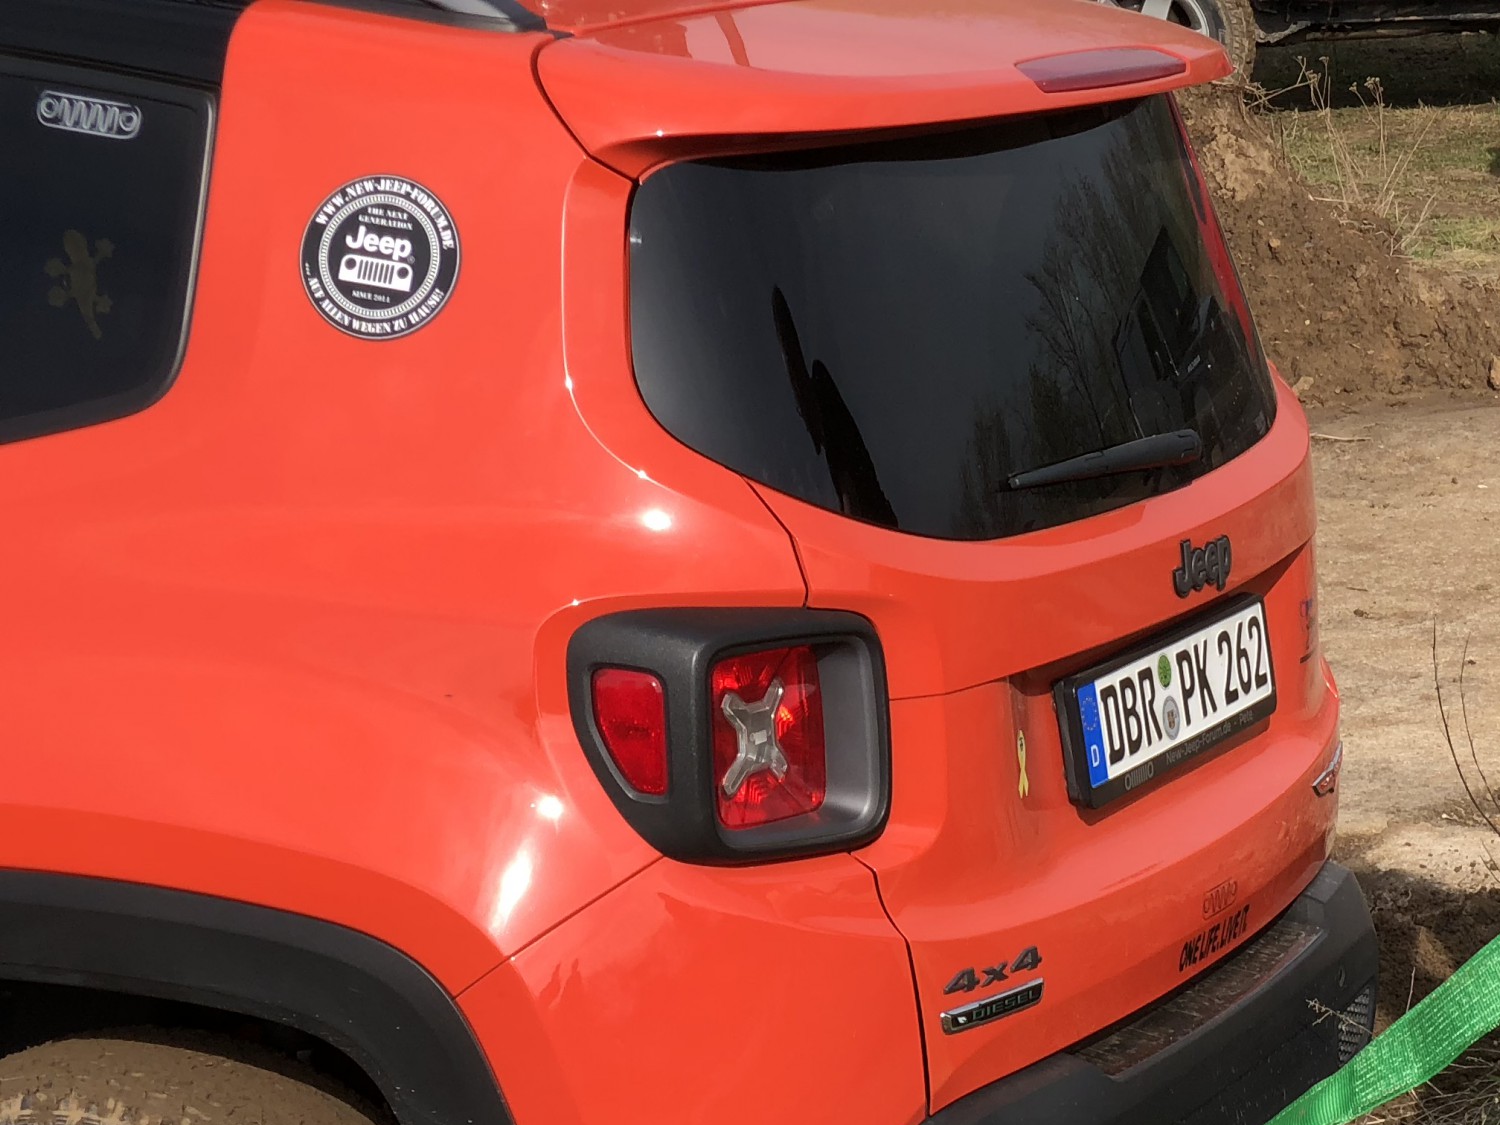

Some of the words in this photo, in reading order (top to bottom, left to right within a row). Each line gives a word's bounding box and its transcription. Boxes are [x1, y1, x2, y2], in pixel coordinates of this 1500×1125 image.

[358, 214, 413, 231] GENERATION
[345, 225, 412, 261] Jeep
[319, 298, 351, 327] ALLEN
[352, 317, 391, 334] WEGEN
[392, 316, 408, 332] ZU
[1172, 534, 1232, 598] Jeep
[1100, 666, 1163, 766] DBR
[1175, 638, 1218, 727] PK
[1217, 615, 1268, 707] 262
[1091, 745, 1100, 768] D
[943, 945, 1042, 995] 4x4
[973, 989, 1040, 1021] DIESEL
